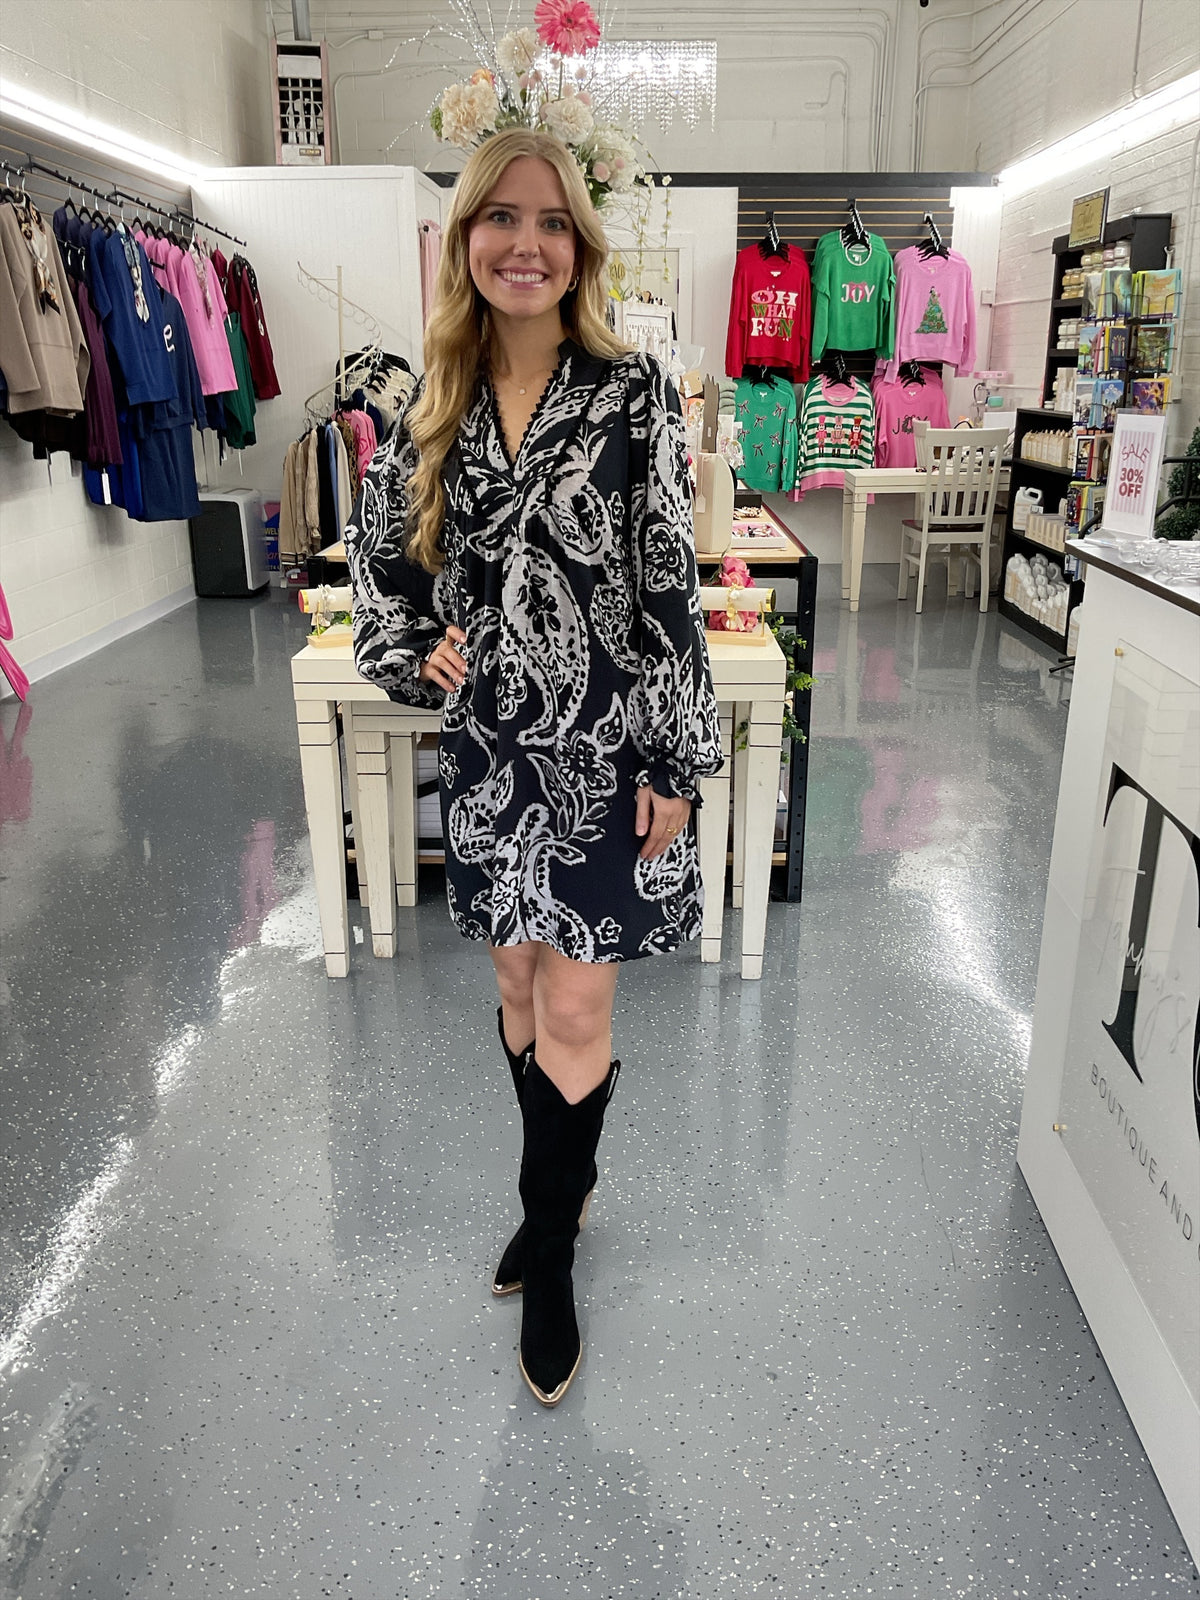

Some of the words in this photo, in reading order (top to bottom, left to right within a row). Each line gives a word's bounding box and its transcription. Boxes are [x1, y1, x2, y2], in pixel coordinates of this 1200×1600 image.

[751, 289, 799, 306] OH
[840, 283, 875, 304] JOY
[752, 303, 796, 319] WHAT
[750, 317, 795, 338] FUN
[892, 415, 928, 435] JO
[1121, 443, 1151, 463] SALE
[1120, 467, 1144, 484] 30%
[1118, 482, 1142, 498] OFF
[1090, 1063, 1157, 1184] BOUTIQUE
[1159, 1180, 1193, 1241] AND
